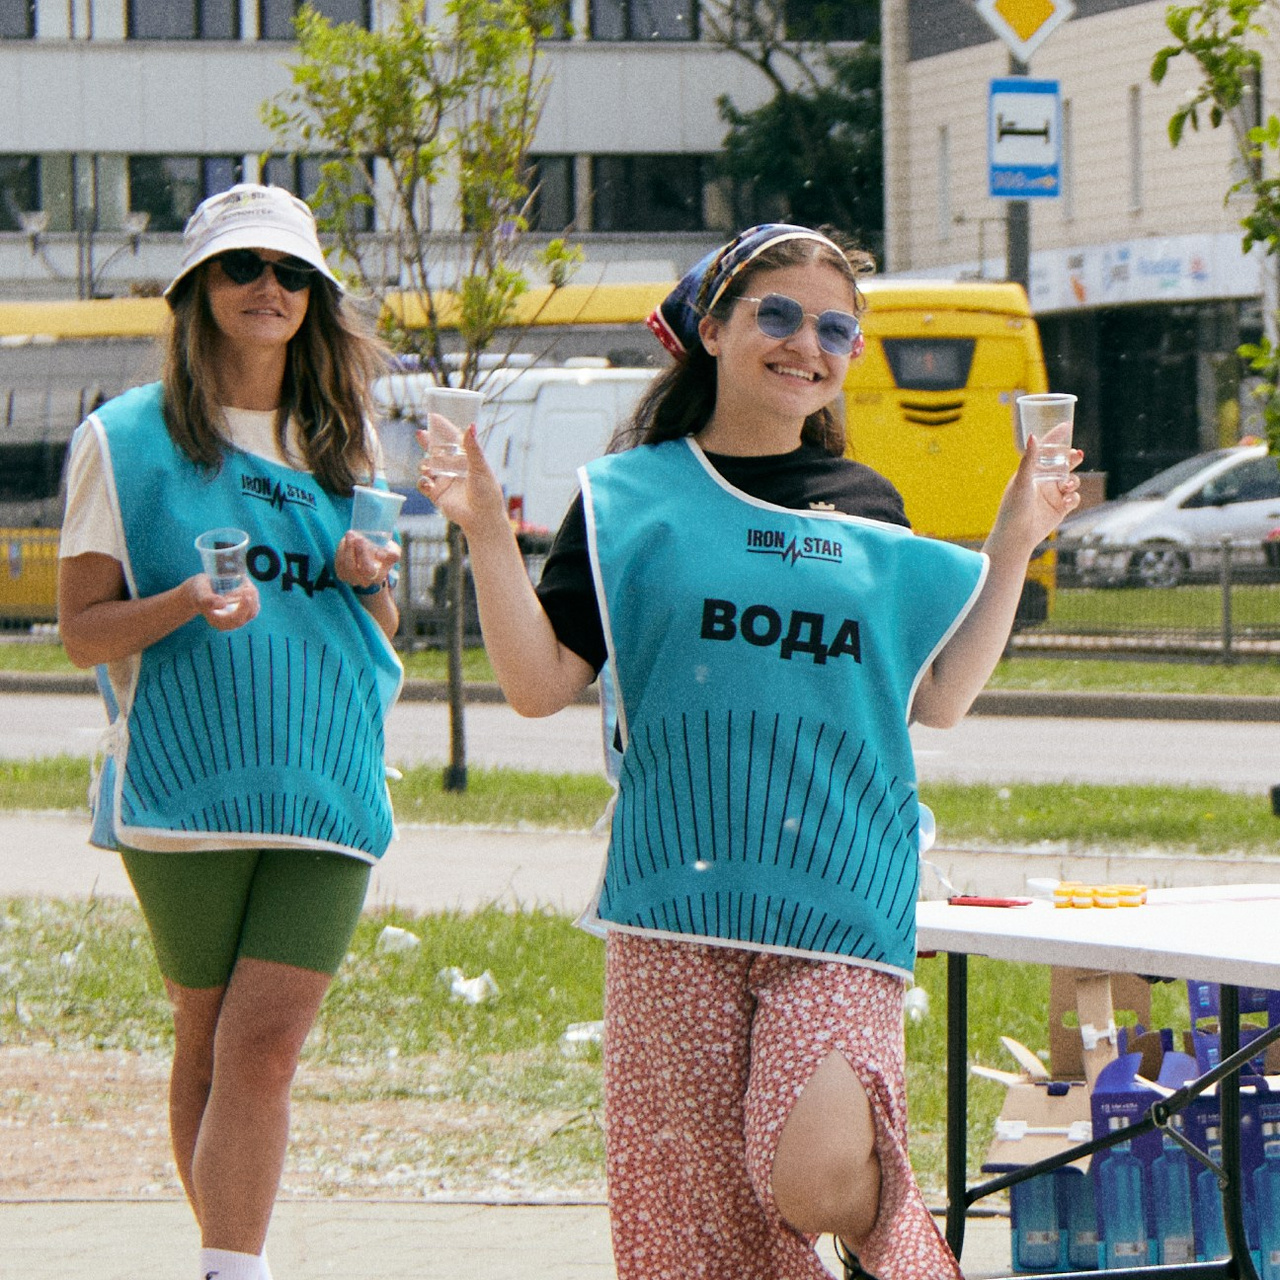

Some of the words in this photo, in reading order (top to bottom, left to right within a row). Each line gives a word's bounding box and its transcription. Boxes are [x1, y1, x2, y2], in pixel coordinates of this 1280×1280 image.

[241, 473, 272, 496] IRON
[747, 528, 785, 549] IRON
[803, 536, 843, 558] STAR
[701, 597, 863, 666] ВОДА
